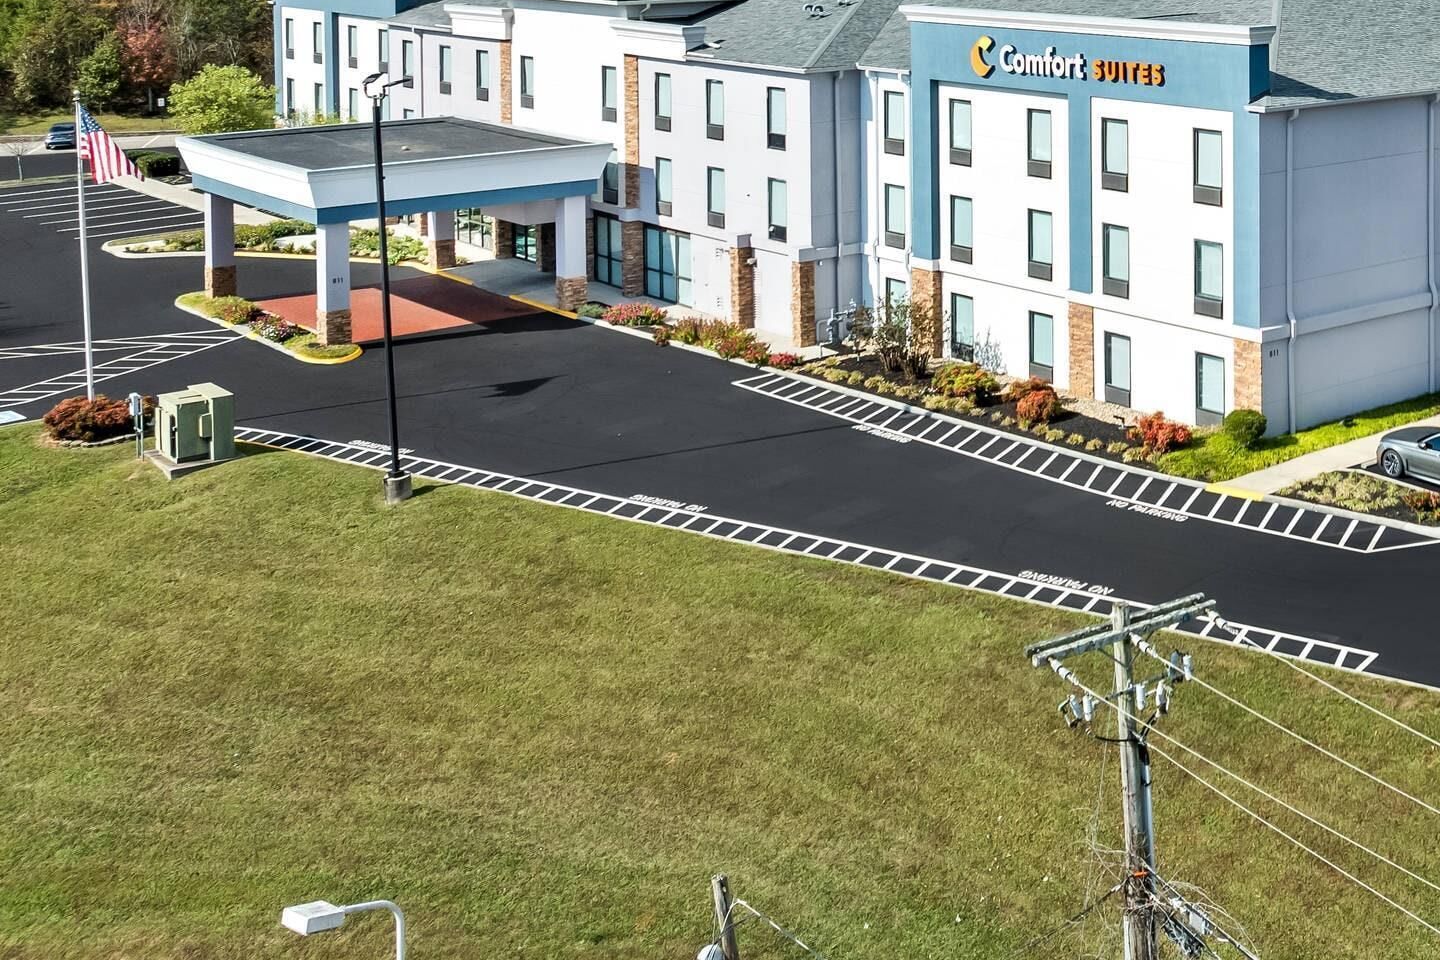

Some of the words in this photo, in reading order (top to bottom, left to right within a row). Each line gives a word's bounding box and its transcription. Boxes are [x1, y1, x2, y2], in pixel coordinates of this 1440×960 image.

[1000, 44, 1087, 80] Comfort
[1091, 59, 1165, 87] SUITES
[629, 494, 687, 509] PARKING
[684, 504, 708, 513] NO
[1105, 499, 1129, 508] NO
[1127, 504, 1189, 522] PARKING
[1018, 570, 1089, 590] PARKING
[1088, 585, 1115, 595] NO
